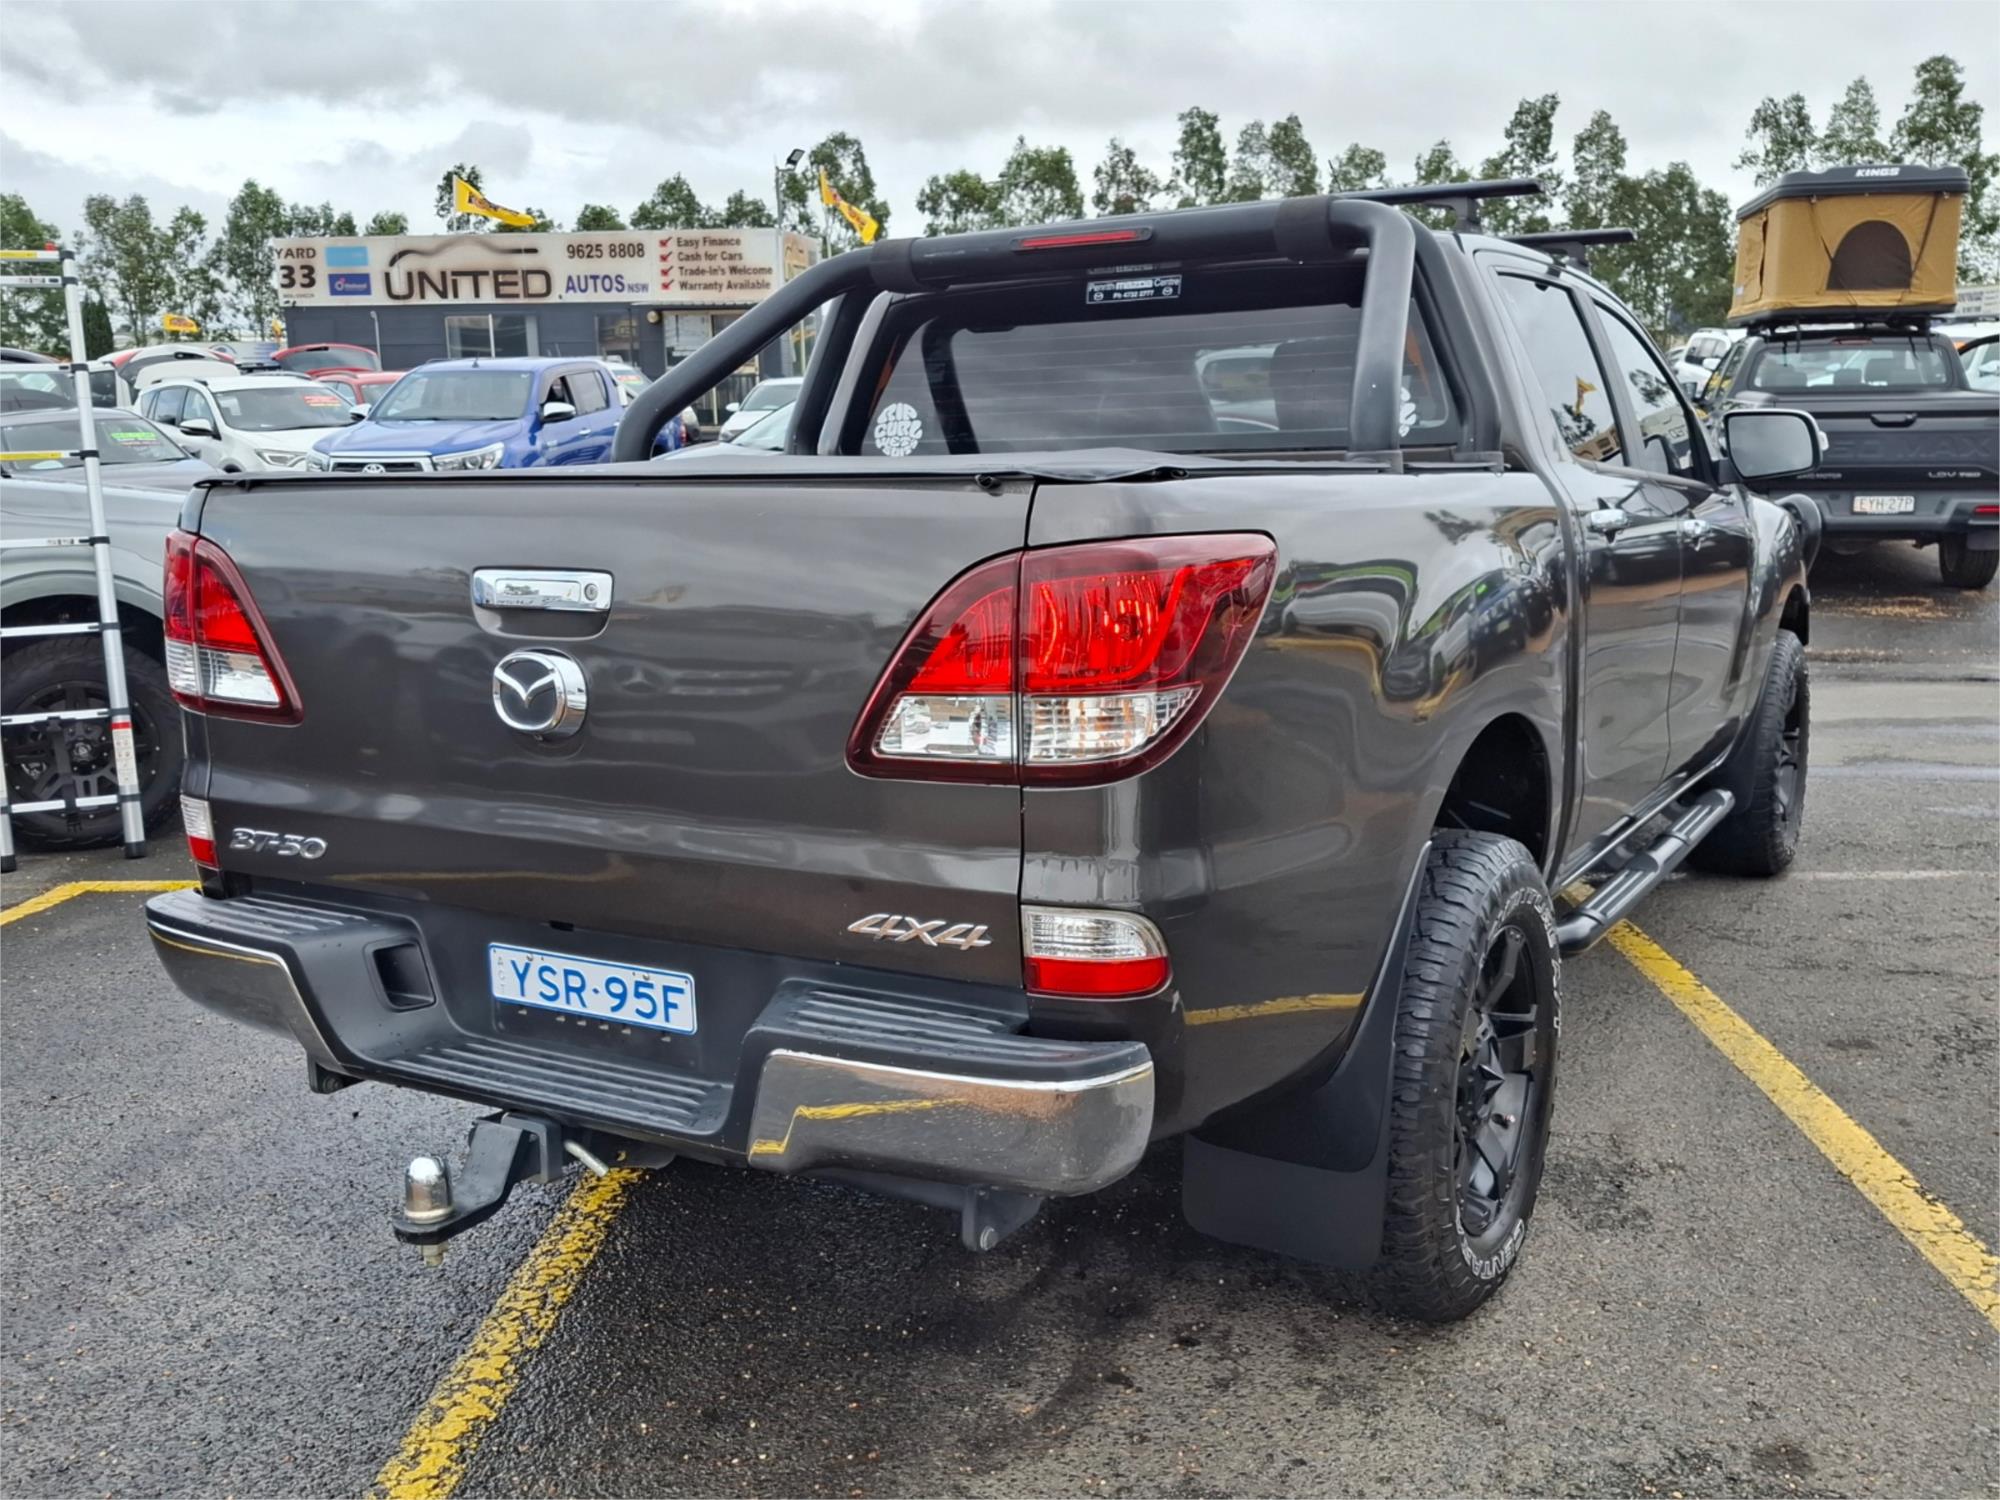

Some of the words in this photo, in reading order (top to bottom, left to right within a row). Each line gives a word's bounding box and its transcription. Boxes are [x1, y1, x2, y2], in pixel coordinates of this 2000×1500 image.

[1855, 167, 1900, 177] KINGS
[677, 237, 699, 249] Easy
[702, 236, 741, 247] Finance
[275, 248, 316, 259] YARD
[567, 244, 603, 258] 9625
[609, 243, 645, 258] 8808
[677, 251, 701, 262] Cash
[704, 250, 718, 261] for
[720, 251, 743, 261] Cars
[279, 265, 316, 288] 33
[728, 265, 773, 275] Welcome
[565, 274, 625, 294] AUTOS
[626, 283, 649, 293] NSW
[679, 280, 723, 293] Warranty
[726, 279, 771, 290] Available
[229, 827, 328, 860] BT-50
